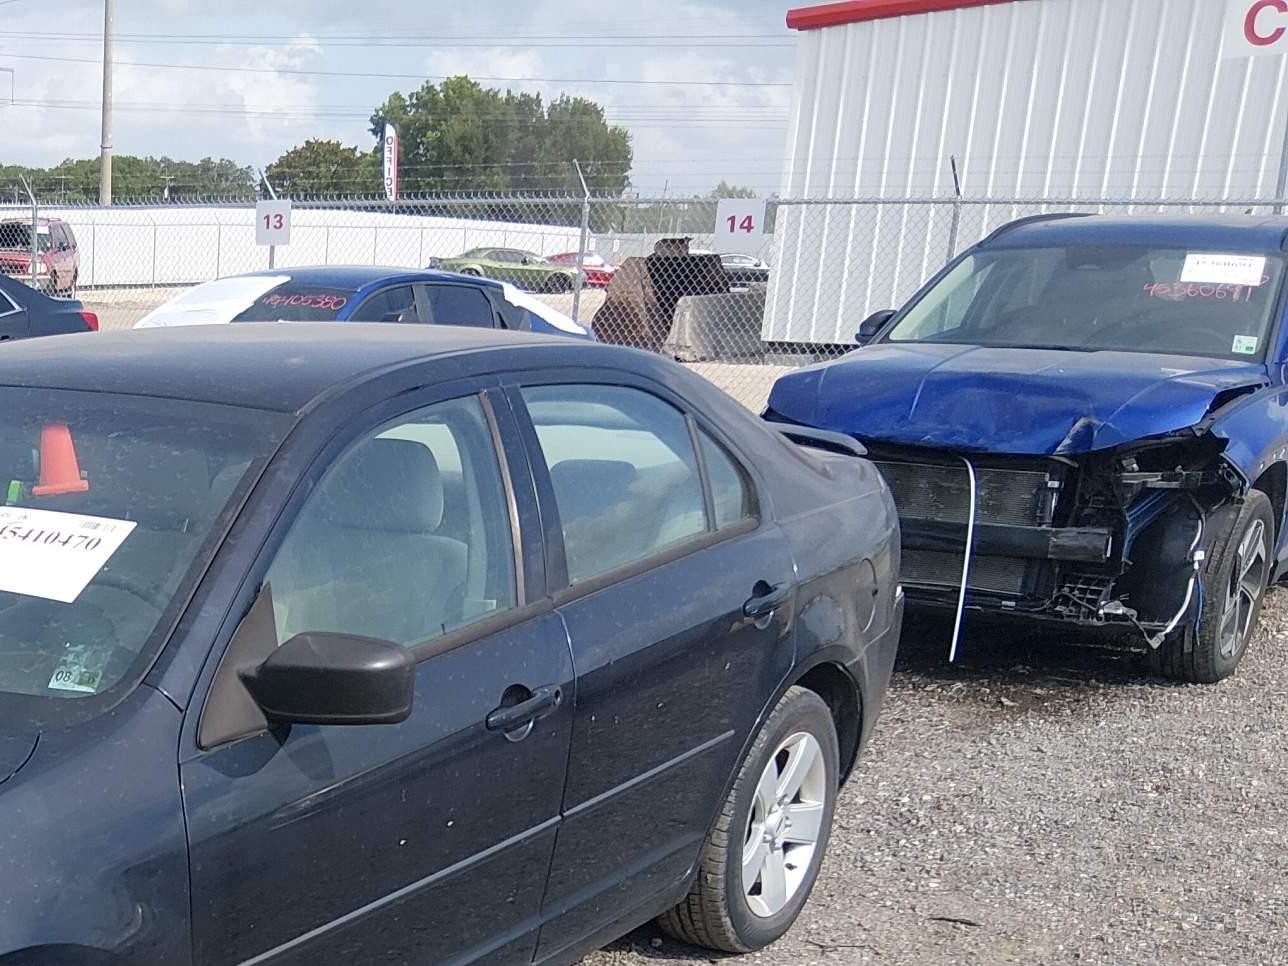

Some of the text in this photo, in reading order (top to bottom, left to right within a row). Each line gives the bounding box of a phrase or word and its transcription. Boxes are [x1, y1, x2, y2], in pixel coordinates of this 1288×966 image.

[1244, 0, 1288, 46] C
[263, 213, 284, 231] 13
[726, 214, 755, 234] 14
[55, 670, 73, 683] 08
